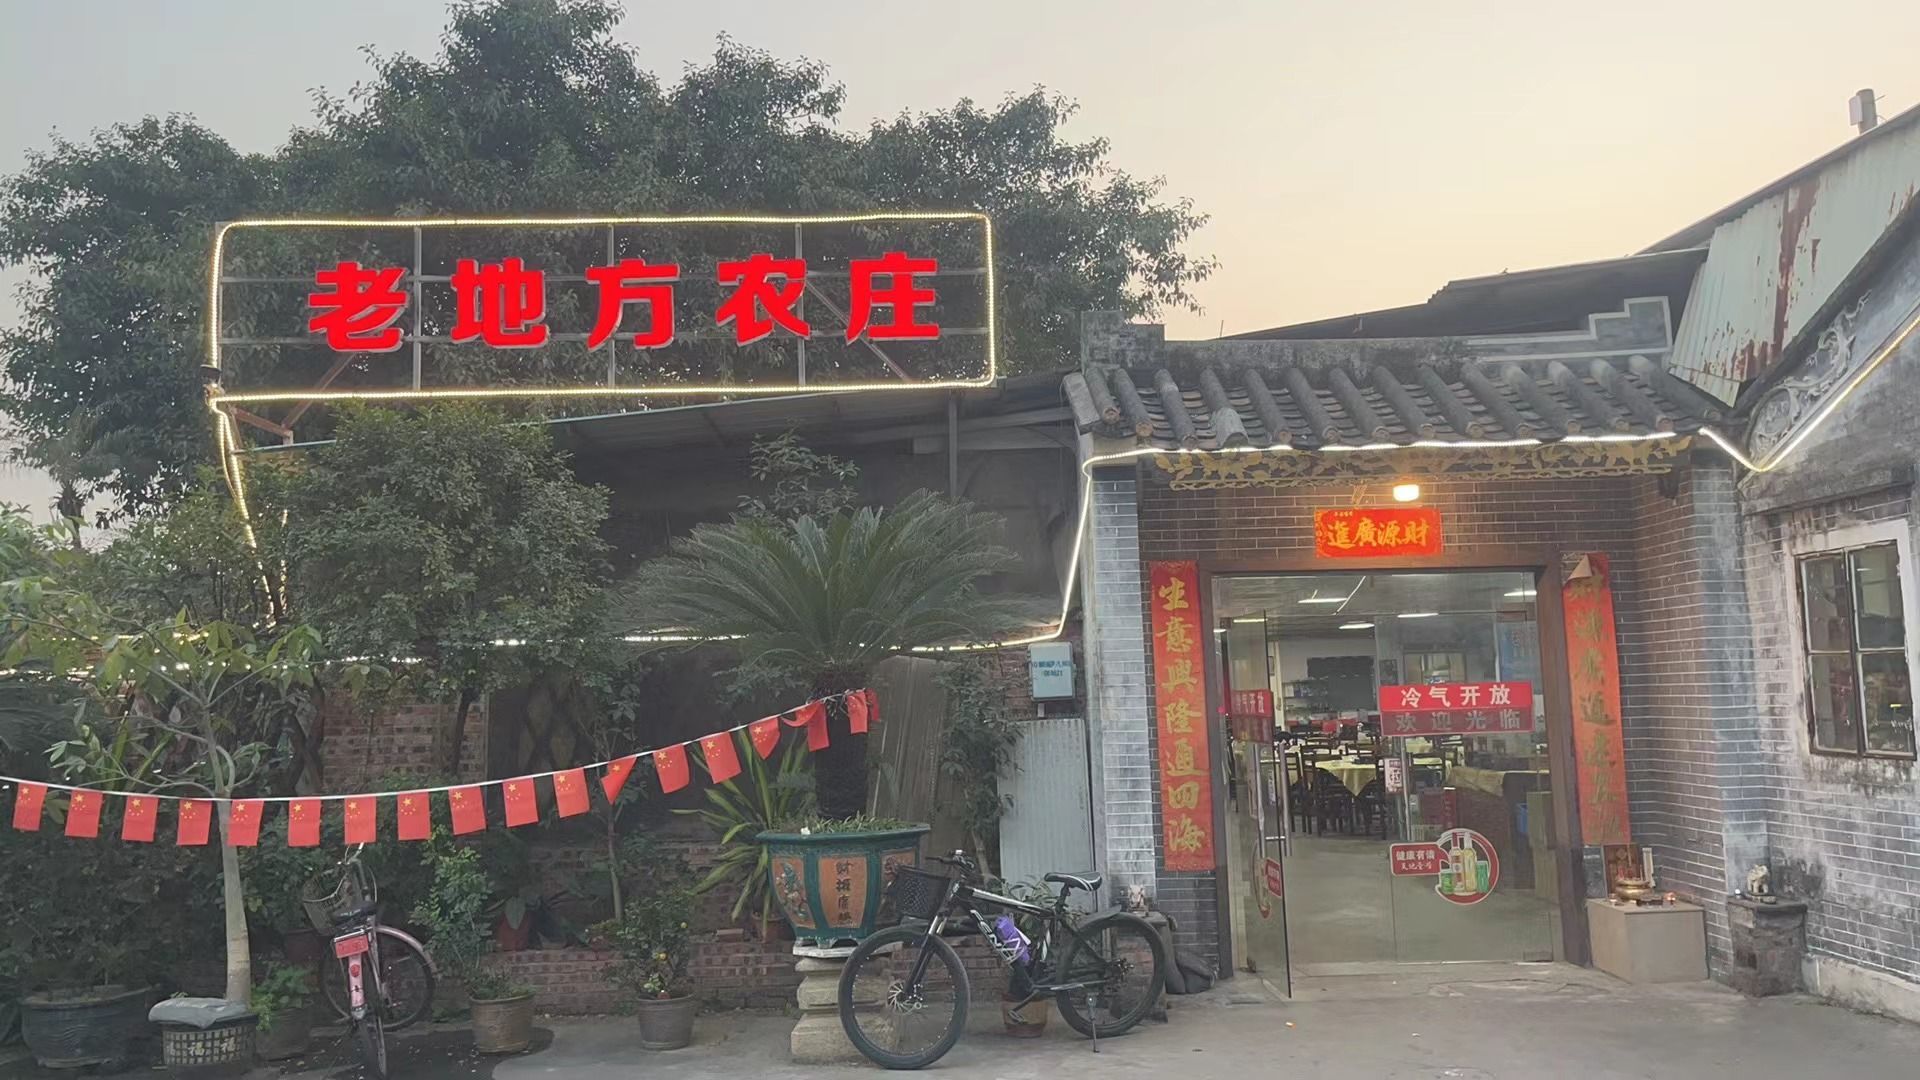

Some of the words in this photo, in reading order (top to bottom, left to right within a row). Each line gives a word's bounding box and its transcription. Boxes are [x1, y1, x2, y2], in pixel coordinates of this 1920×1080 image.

[308, 252, 942, 352] 老地方农庄
[1401, 684, 1511, 708] 冷气开放
[1396, 708, 1520, 732] 欢迎光临
